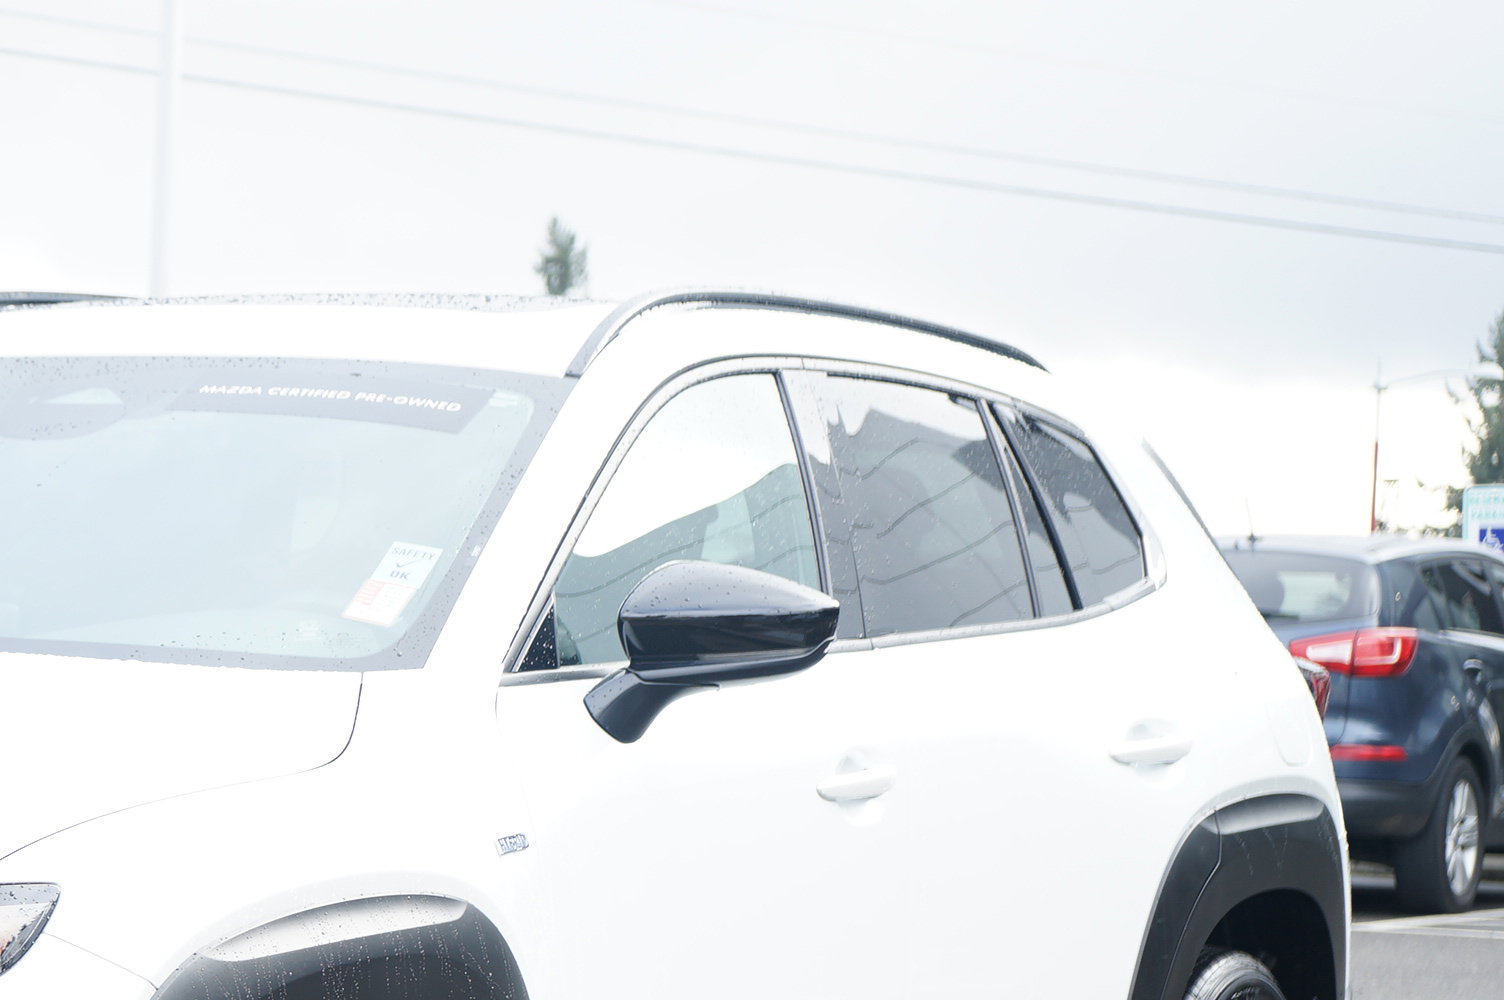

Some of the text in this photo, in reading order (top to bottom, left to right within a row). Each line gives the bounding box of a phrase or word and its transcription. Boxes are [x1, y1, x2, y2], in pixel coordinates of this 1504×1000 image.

[199, 385, 461, 412] MAZDA CERTIFIED PRE-OWNED
[391, 547, 436, 560] SAFETY
[390, 570, 411, 580] OK
